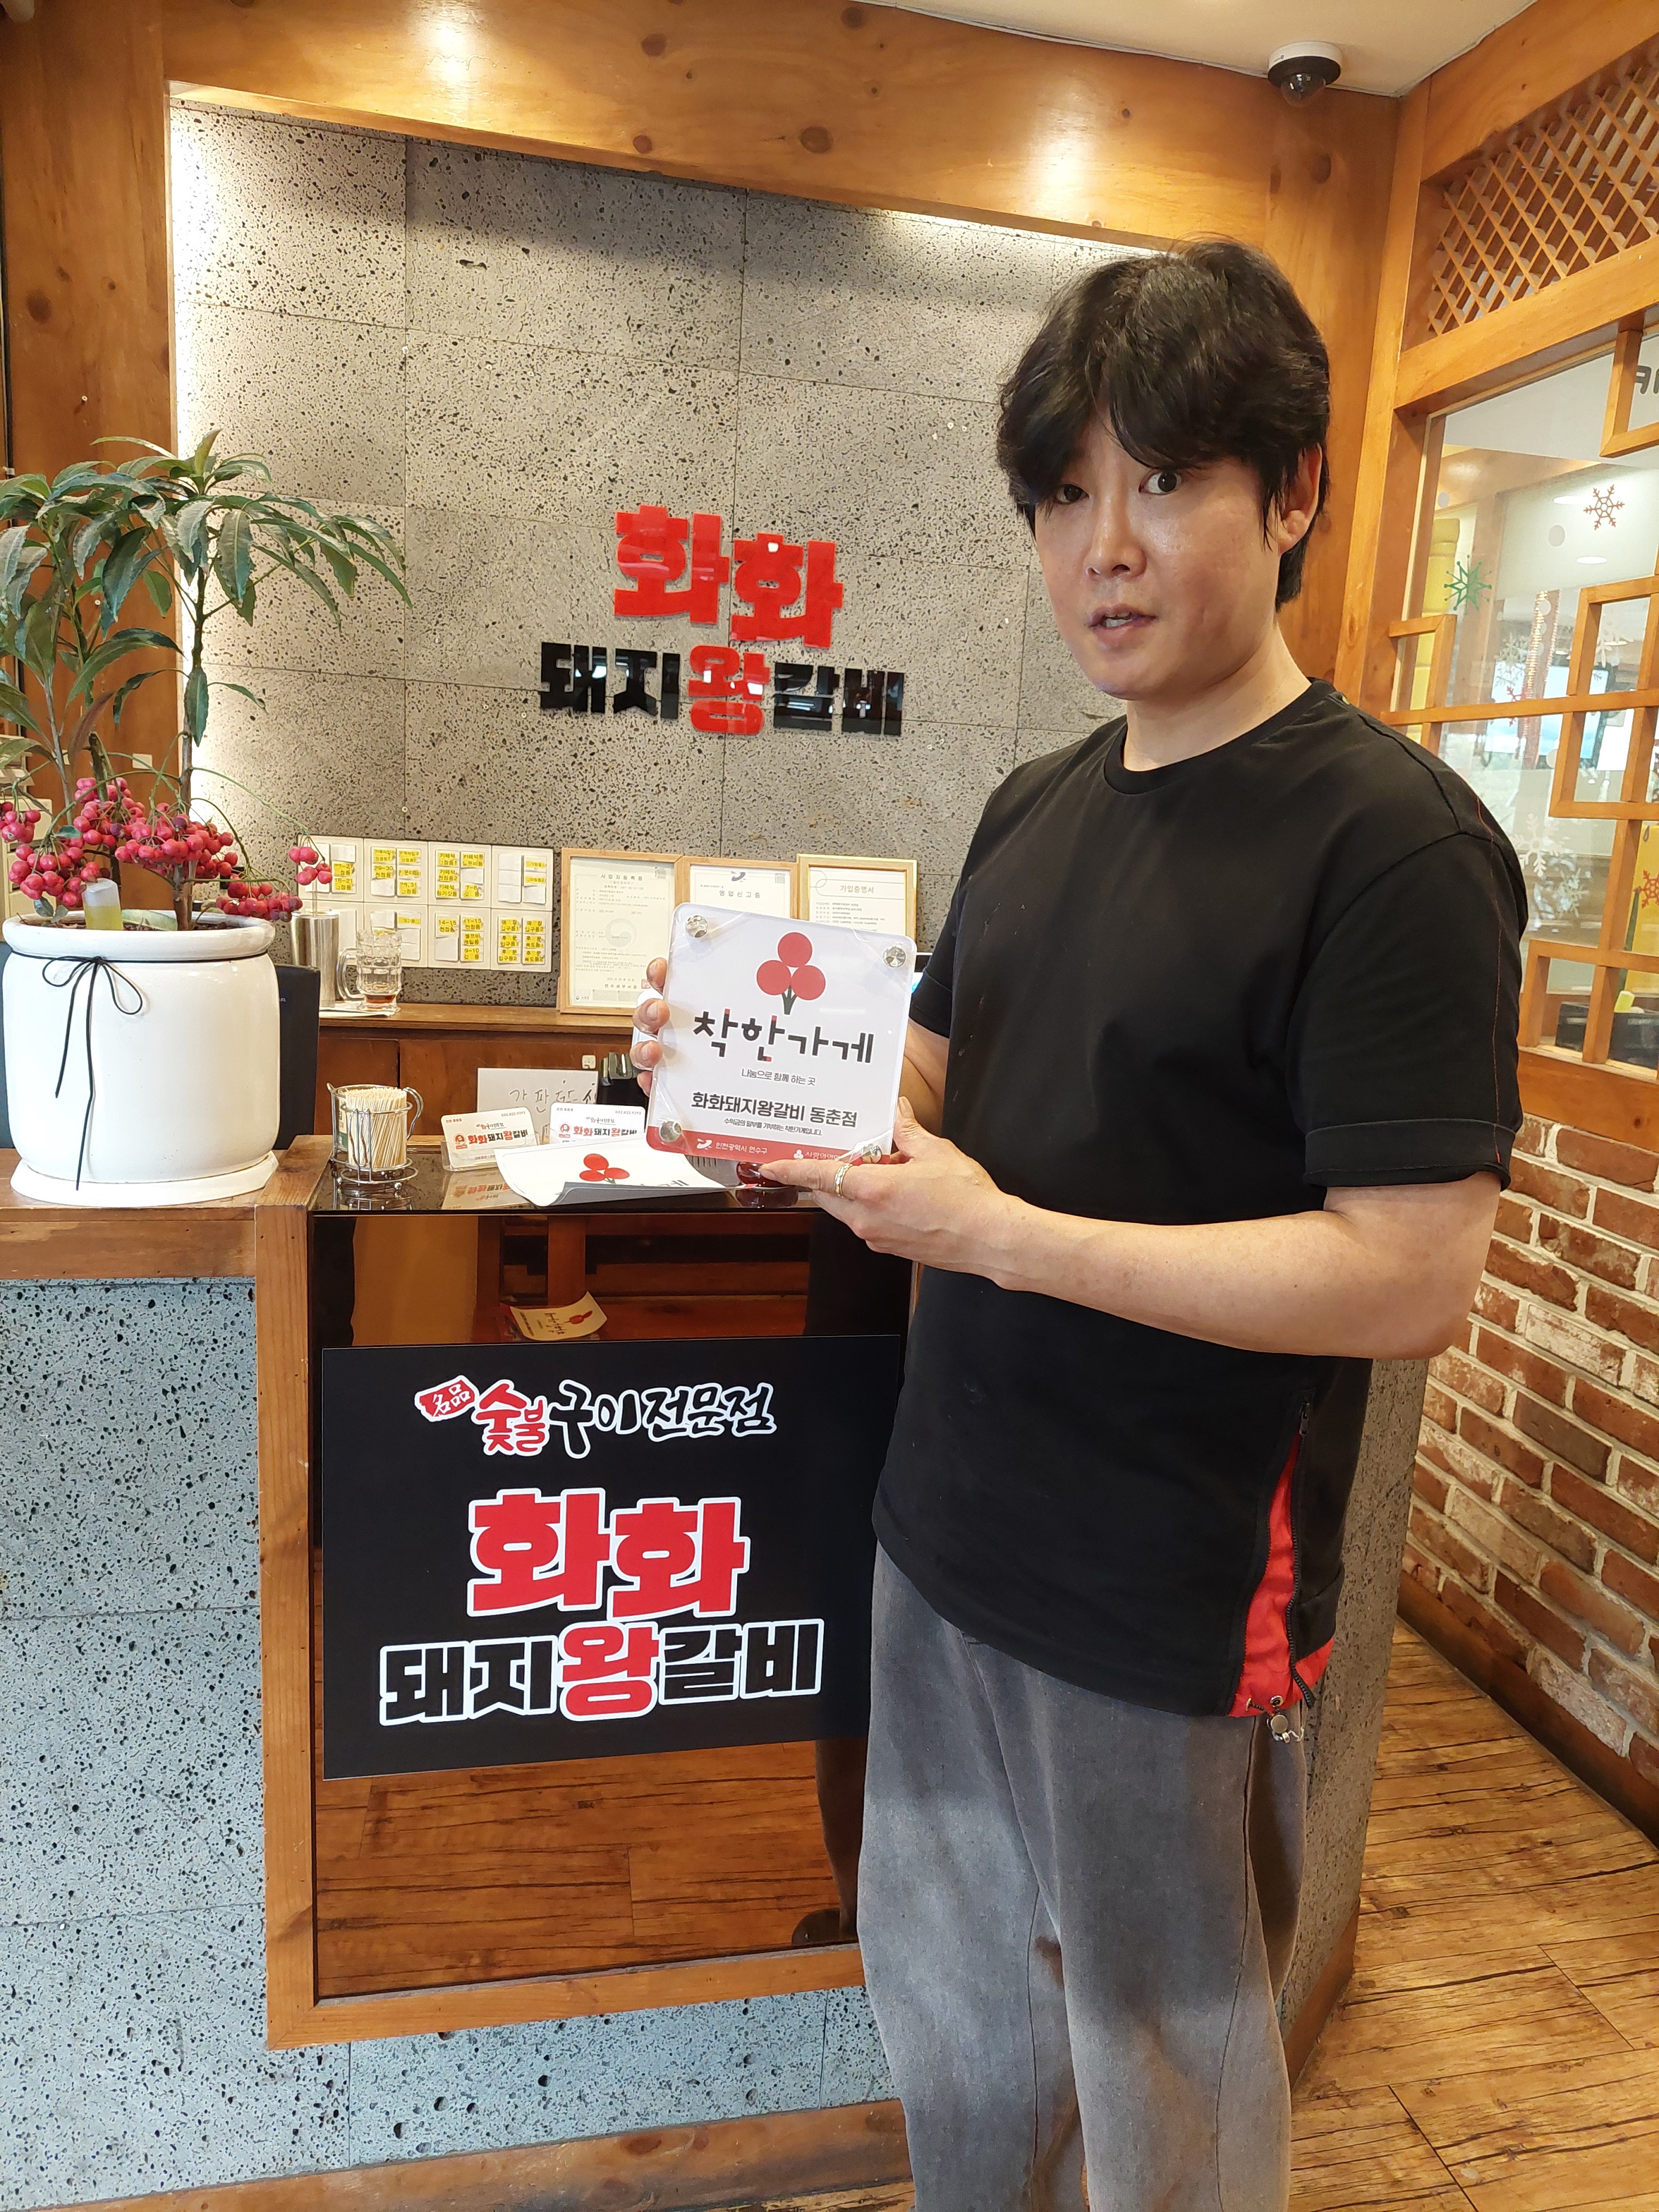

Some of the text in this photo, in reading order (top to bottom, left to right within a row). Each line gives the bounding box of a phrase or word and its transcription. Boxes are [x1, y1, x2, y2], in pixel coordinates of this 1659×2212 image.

[614, 505, 844, 649] 화화
[540, 642, 905, 736] 돼지왕갈비
[719, 890, 760, 899] 영업신고증
[840, 885, 875, 894] 가입증명서
[693, 1009, 874, 1064] 착한가게
[741, 1068, 816, 1086] 나눔으로 함께 하는 곳
[691, 1092, 857, 1128] 화화돼지왕갈비 동춘점
[468, 1129, 528, 1144] 화화돼지왕갈비
[723, 1117, 823, 1136] 수익금의 일부를 기부하는 착한가게입니다.
[716, 1141, 768, 1155] 인천광역시 연수구
[467, 1487, 751, 1620] 화화
[380, 1618, 824, 1727] 돼지왕갈비
